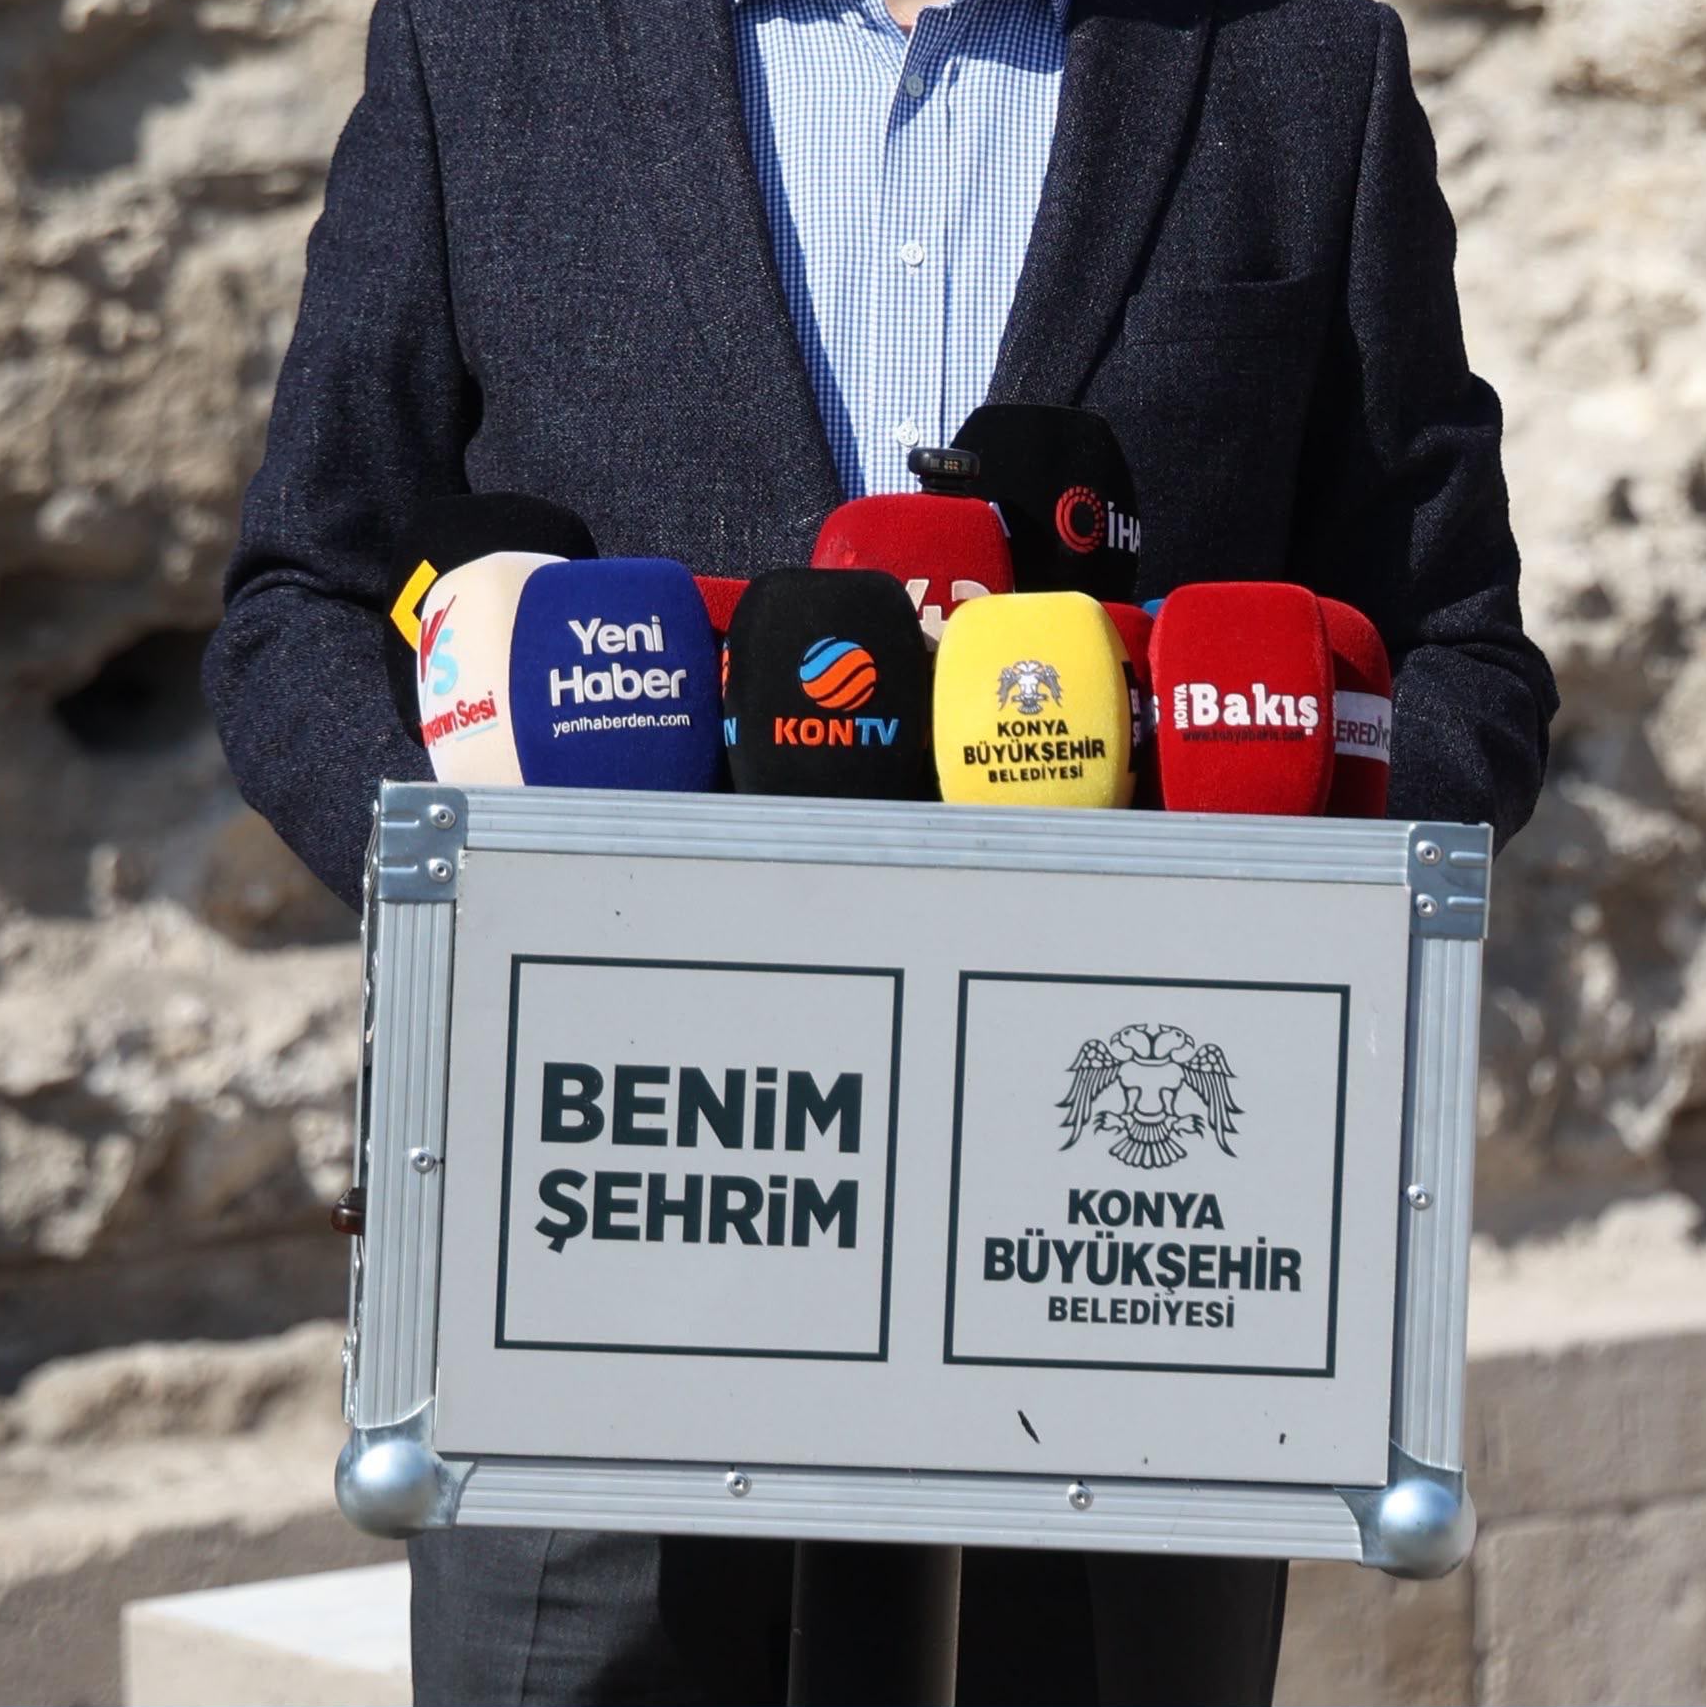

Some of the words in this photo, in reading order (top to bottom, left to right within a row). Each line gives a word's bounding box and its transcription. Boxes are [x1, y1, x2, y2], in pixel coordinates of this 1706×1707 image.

[568, 614, 664, 655] Yeni
[550, 662, 687, 707] Haber
[456, 690, 498, 729] Sesi
[552, 713, 691, 738] yenihaberden.com
[1173, 683, 1189, 730] KONYA
[1189, 682, 1320, 736] Bakış
[997, 719, 1069, 738] KONYA
[963, 736, 1106, 766] BÜYÜKŞEHİR
[988, 762, 1083, 783] BELEDİYESİ
[1067, 1188, 1225, 1230] KONYA
[983, 1228, 1302, 1296] BÜYÜKŞEHİR
[1047, 1293, 1235, 1329] BELEDİYESİ
